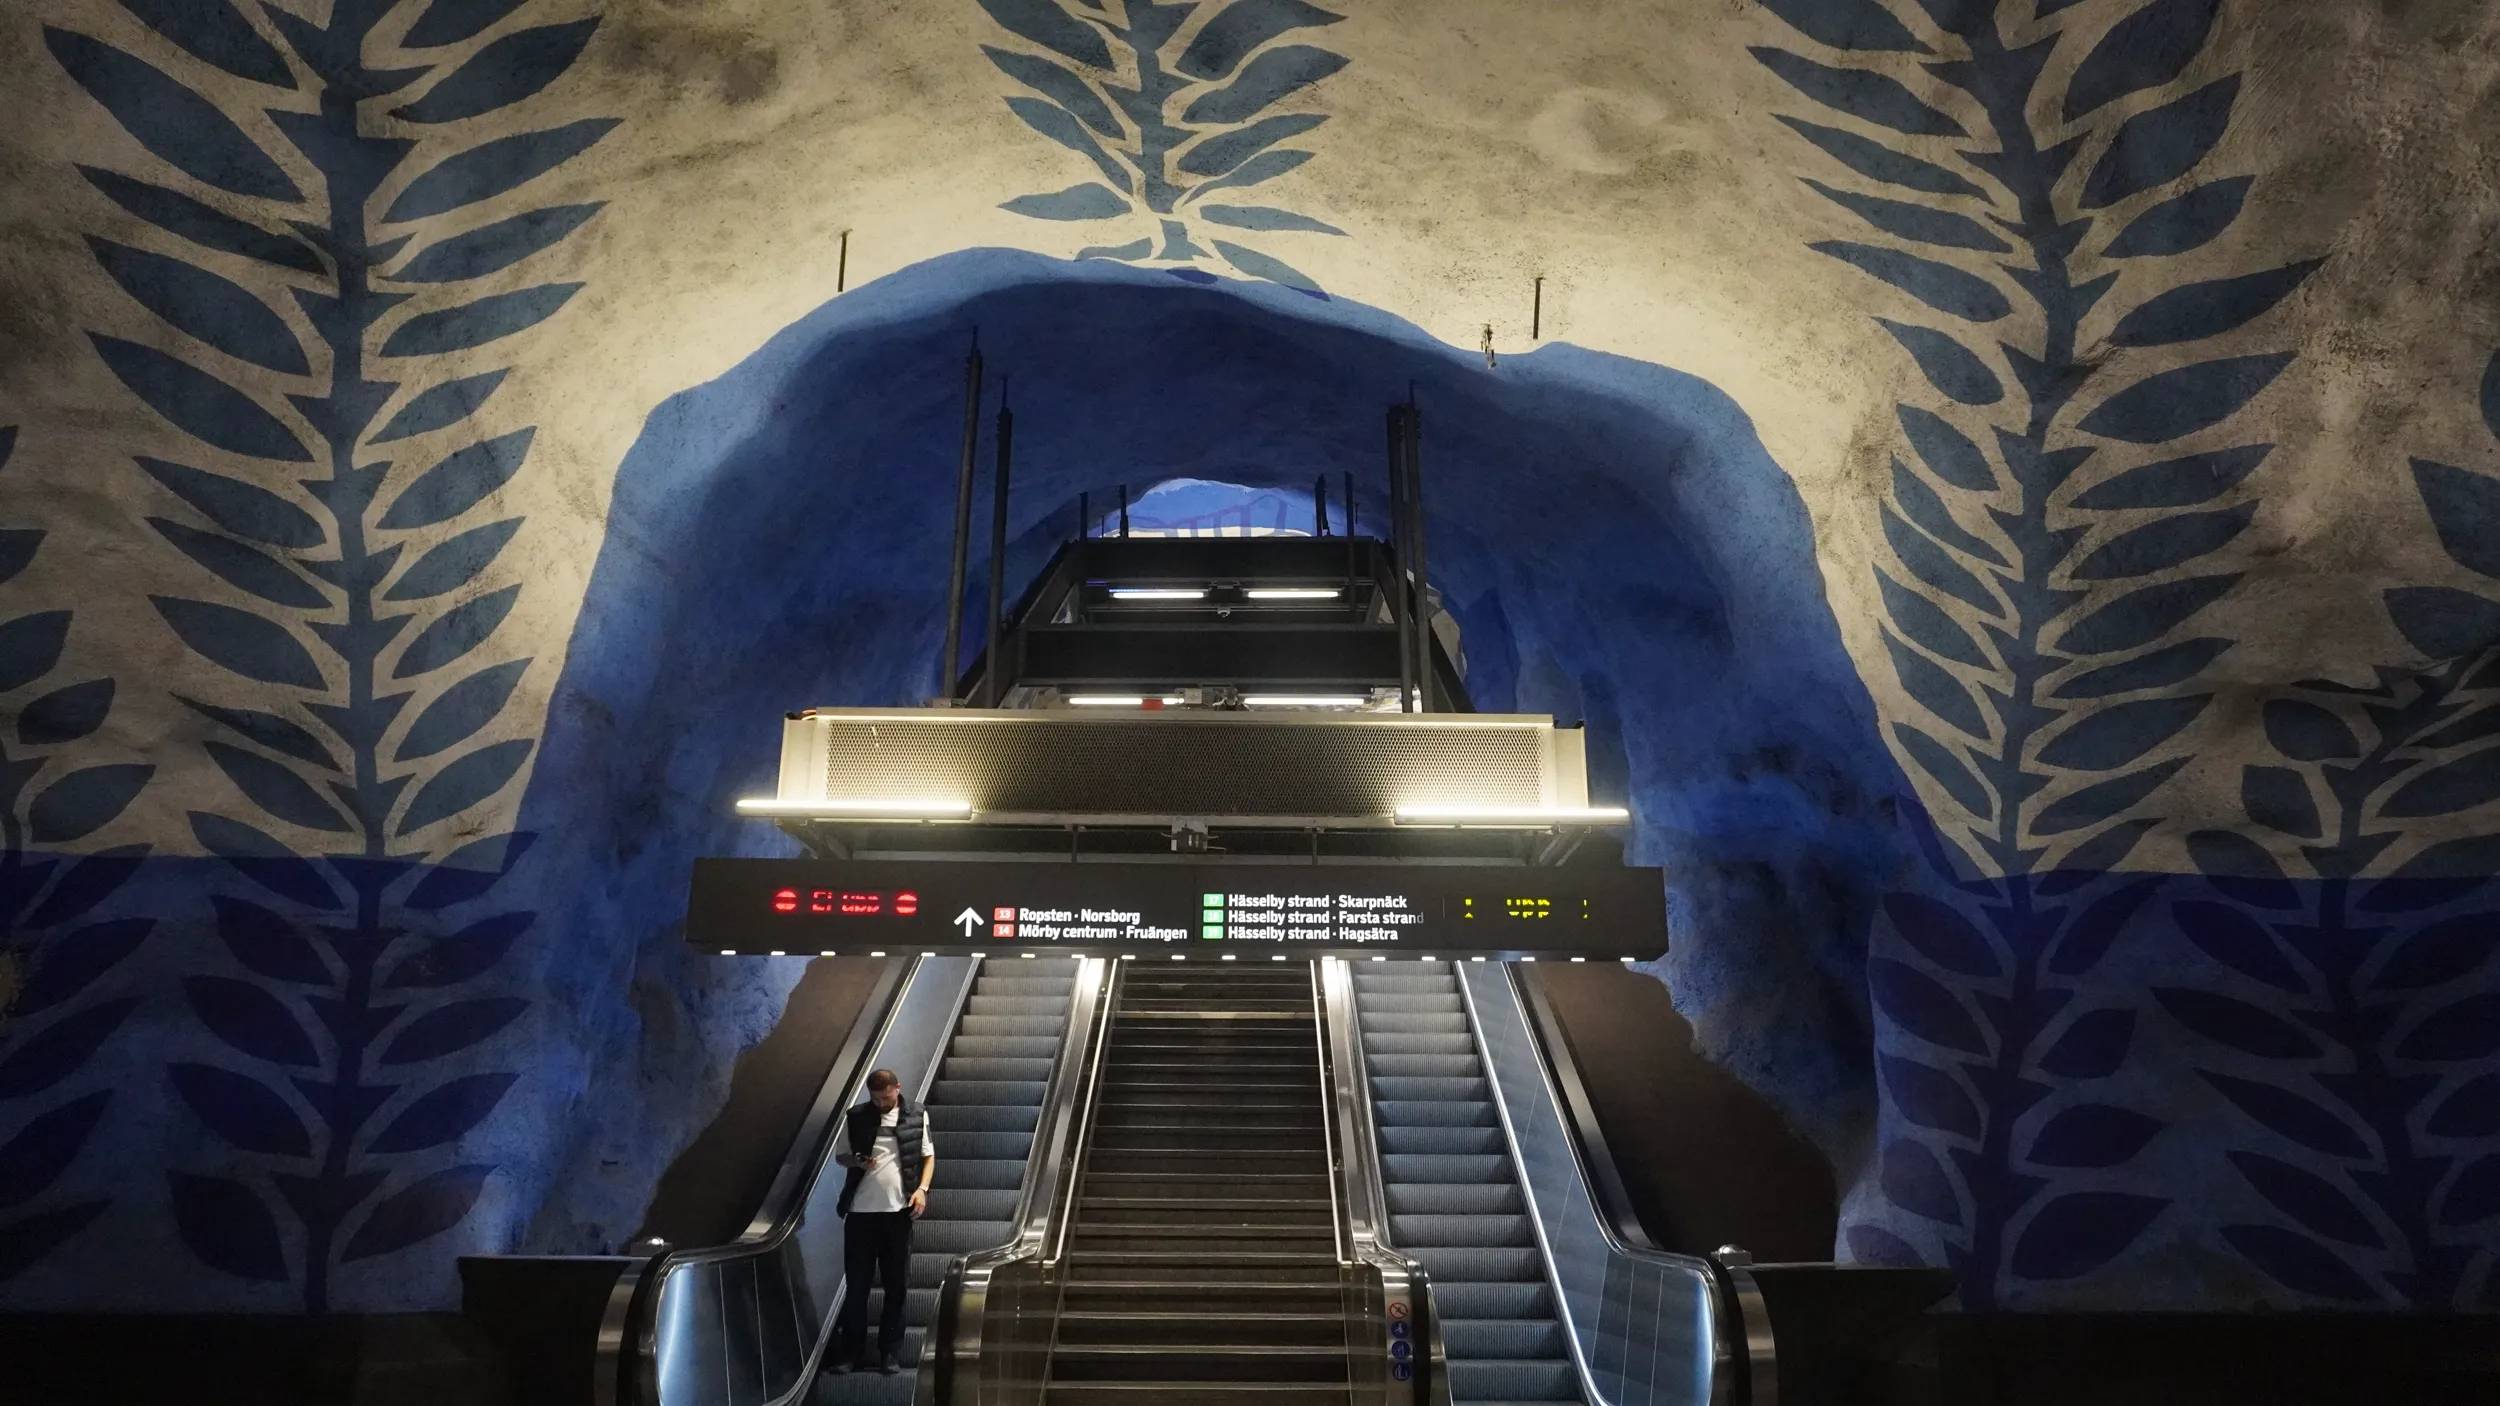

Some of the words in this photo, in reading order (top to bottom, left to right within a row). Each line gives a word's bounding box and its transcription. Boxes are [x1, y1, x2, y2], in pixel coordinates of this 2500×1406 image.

[1228, 894, 1285, 909] Hässelby
[1288, 895, 1330, 908] strand
[1339, 895, 1407, 910] Skarpnäck
[1020, 908, 1072, 923] Ropsten
[1081, 909, 1140, 924] Norsborg
[1228, 910, 1285, 925] Hässelby
[1288, 911, 1330, 924] strand
[1339, 911, 1380, 924] Farsta
[1383, 911, 1424, 924] strand
[1019, 924, 1061, 939] Mörby
[1063, 926, 1117, 938] centrum
[1126, 926, 1187, 941] Fruängen
[1228, 926, 1285, 941] Hässelby
[1288, 927, 1330, 940] strand
[1339, 927, 1398, 941] Hagsätra
